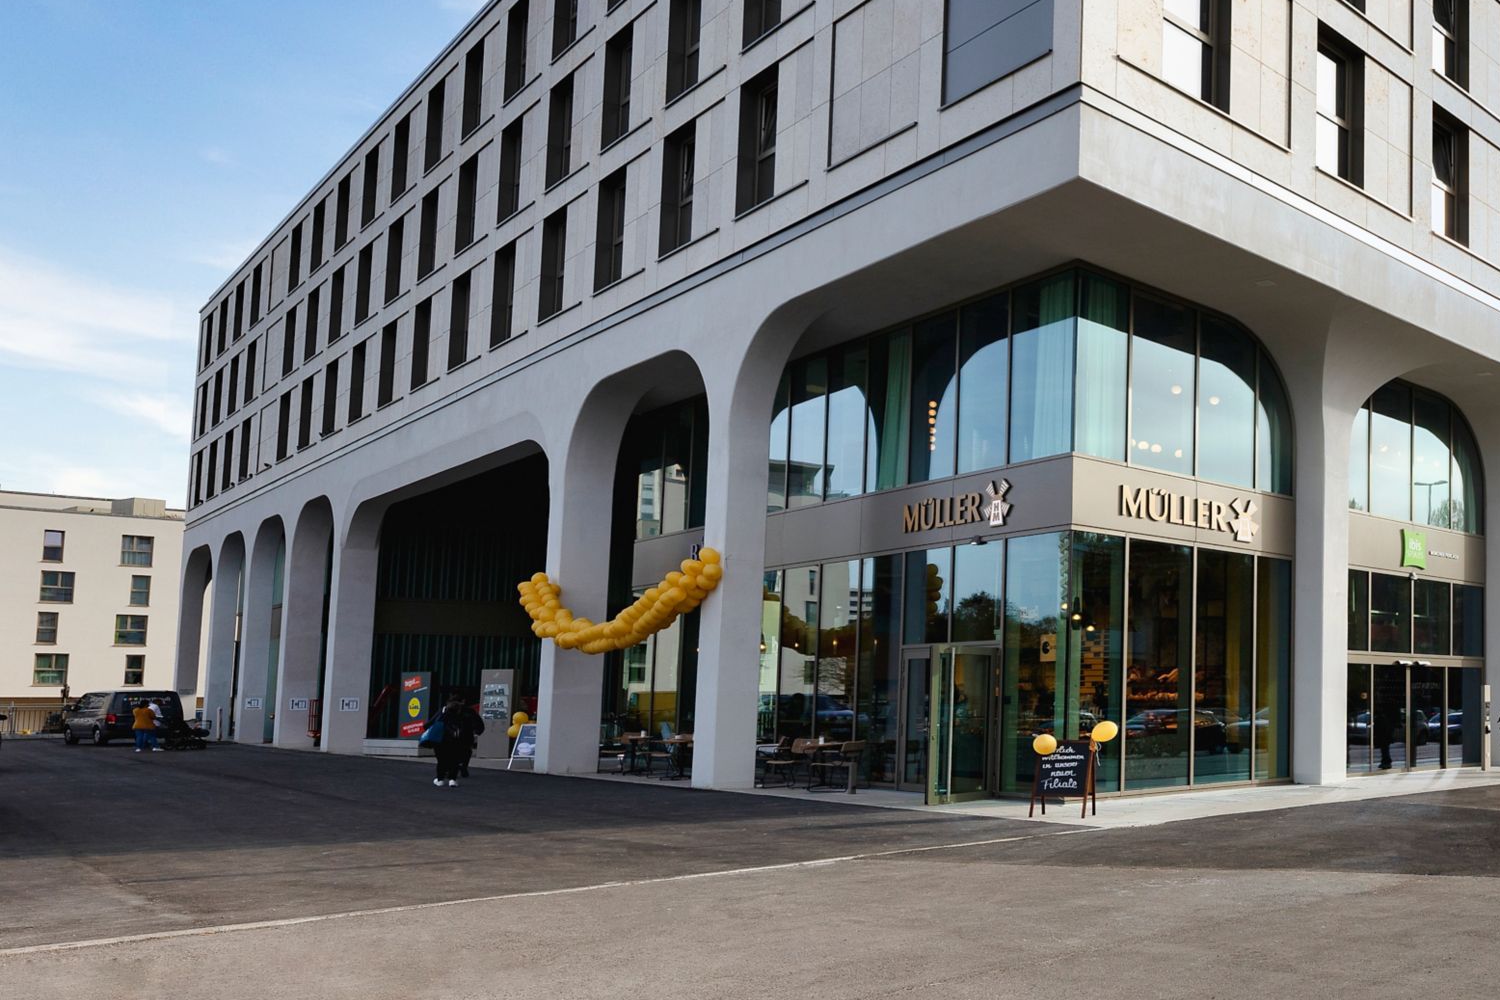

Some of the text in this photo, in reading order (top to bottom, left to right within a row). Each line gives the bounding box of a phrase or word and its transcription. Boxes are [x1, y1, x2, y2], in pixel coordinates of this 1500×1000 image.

[903, 492, 982, 534] MÜLLER
[1119, 484, 1227, 532] MÜLLER
[1041, 778, 1078, 790] Filiale
